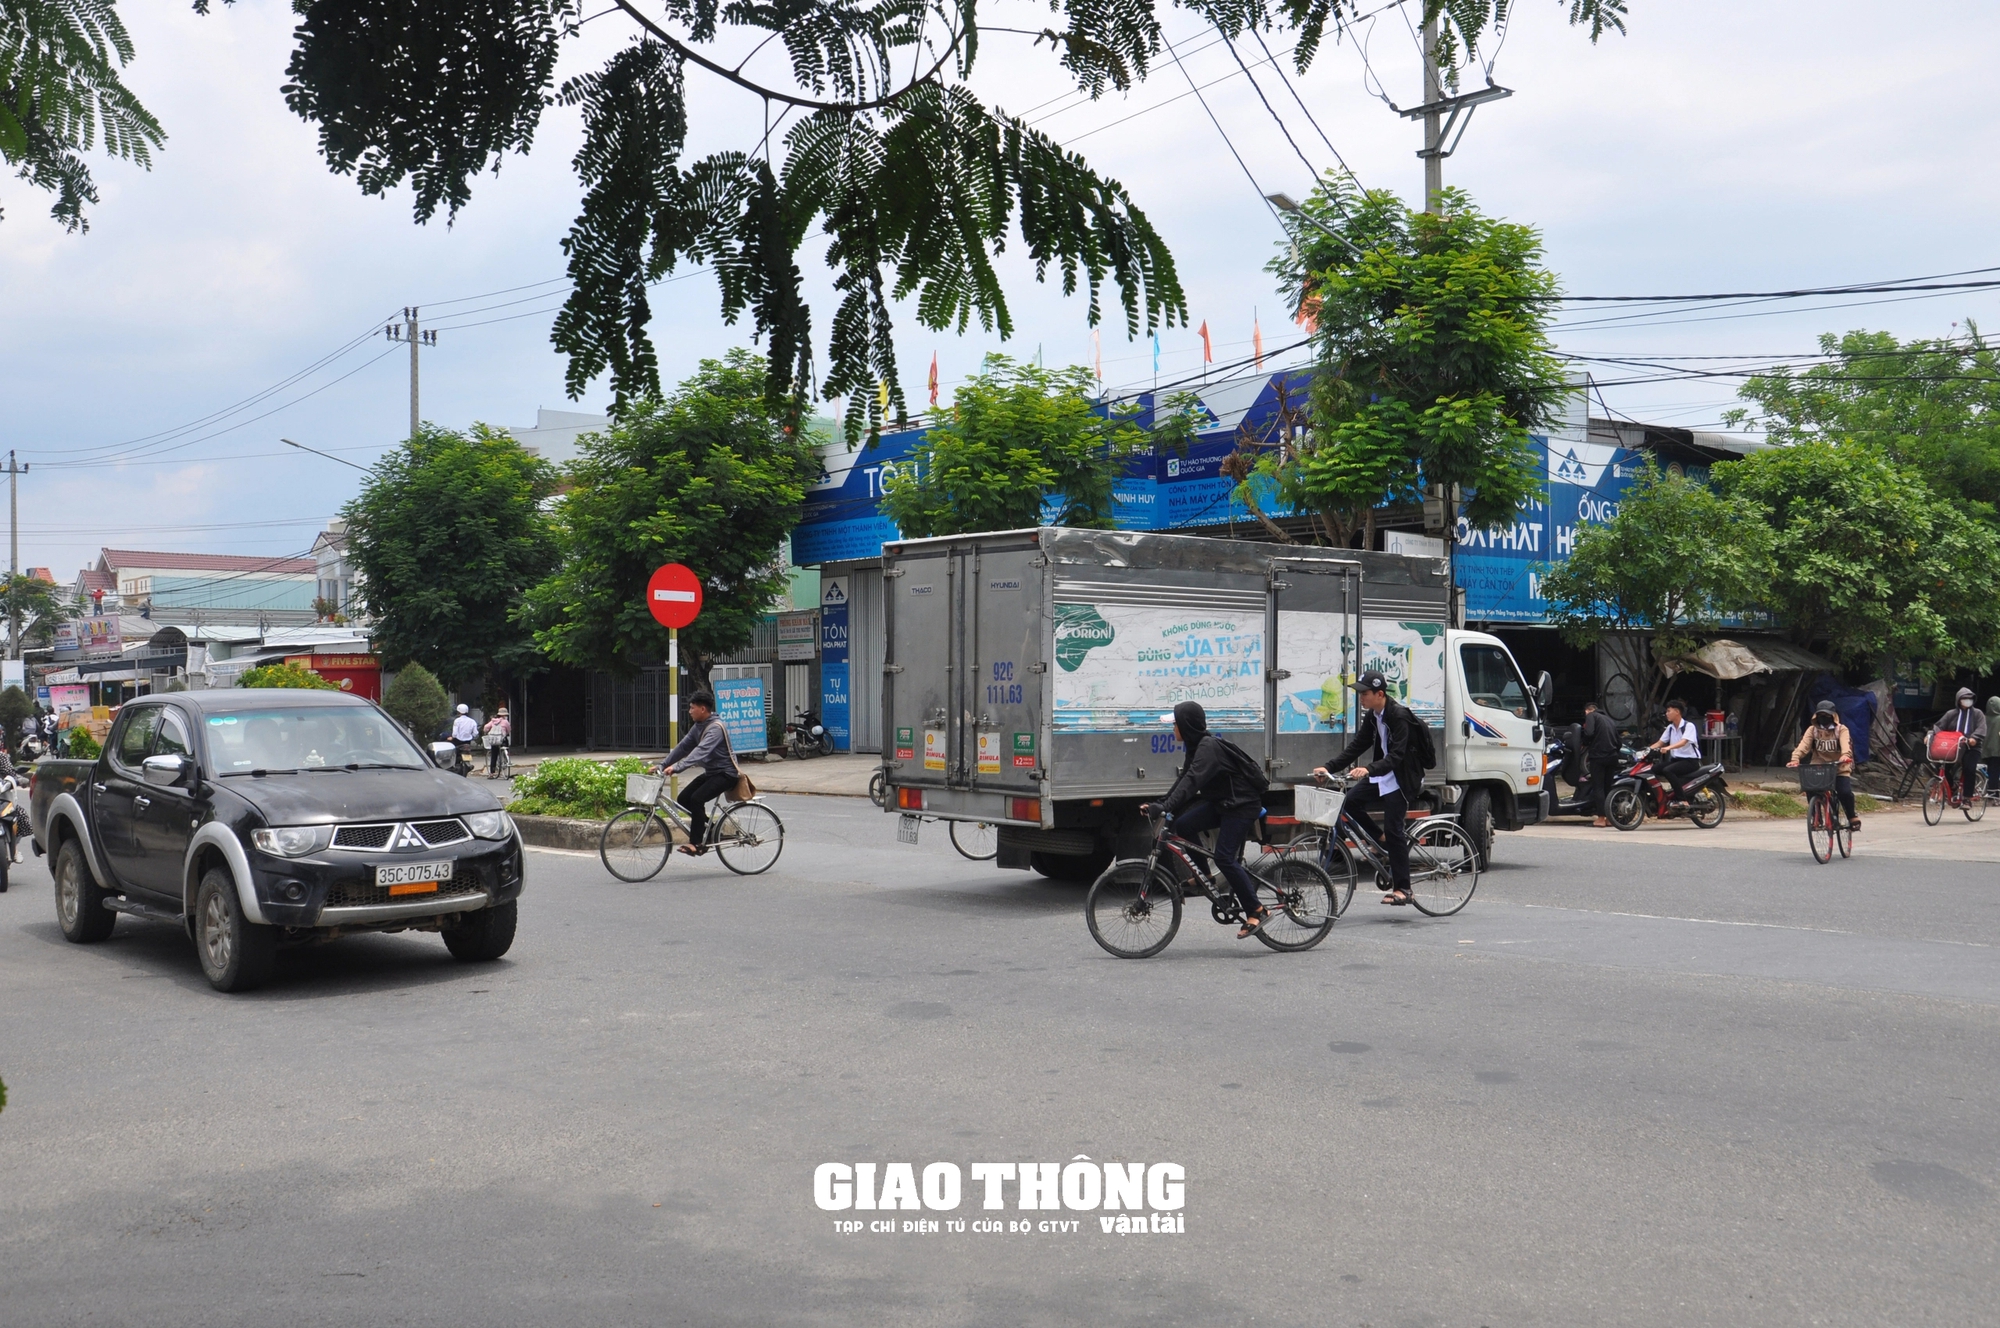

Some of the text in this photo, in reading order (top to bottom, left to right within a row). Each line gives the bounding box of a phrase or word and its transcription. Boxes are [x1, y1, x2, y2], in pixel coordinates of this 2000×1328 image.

[1168, 484, 1188, 494] CÔNG
[1189, 484, 1196, 492] TY
[1197, 482, 1216, 491] TNHH
[1113, 493, 1156, 504] MINH HUY
[1168, 495, 1188, 506] NHÀ
[1190, 492, 1208, 504] MÁY
[1579, 491, 1610, 522] ỐNG
[852, 523, 872, 532] THÀNH
[873, 521, 887, 530] VIÊN
[1486, 565, 1499, 574] TÔN
[1500, 567, 1514, 576] THÉP
[911, 586, 932, 594] THACO
[990, 581, 1020, 590] HYUNDAI
[1479, 576, 1496, 590] CÁN
[1499, 578, 1515, 591] TÔN
[823, 623, 847, 639] TÔN
[1071, 628, 1109, 640] ORION
[1162, 622, 1189, 638] KHÔNG
[1190, 620, 1212, 630] DÙNG
[331, 657, 375, 665] FIVE STAR
[1137, 647, 1172, 663] DÙNG
[993, 661, 1014, 681] 92C
[830, 678, 841, 691] TỰ
[717, 686, 760, 700] TỰ TOÀN
[824, 691, 847, 704] TOÀN
[986, 684, 1023, 704] 111.63
[721, 698, 758, 709] NHÀ MÁY
[720, 706, 762, 720] CÁN TÔN
[926, 751, 945, 759] RIMULA
[379, 863, 450, 884] 35C-075.43
